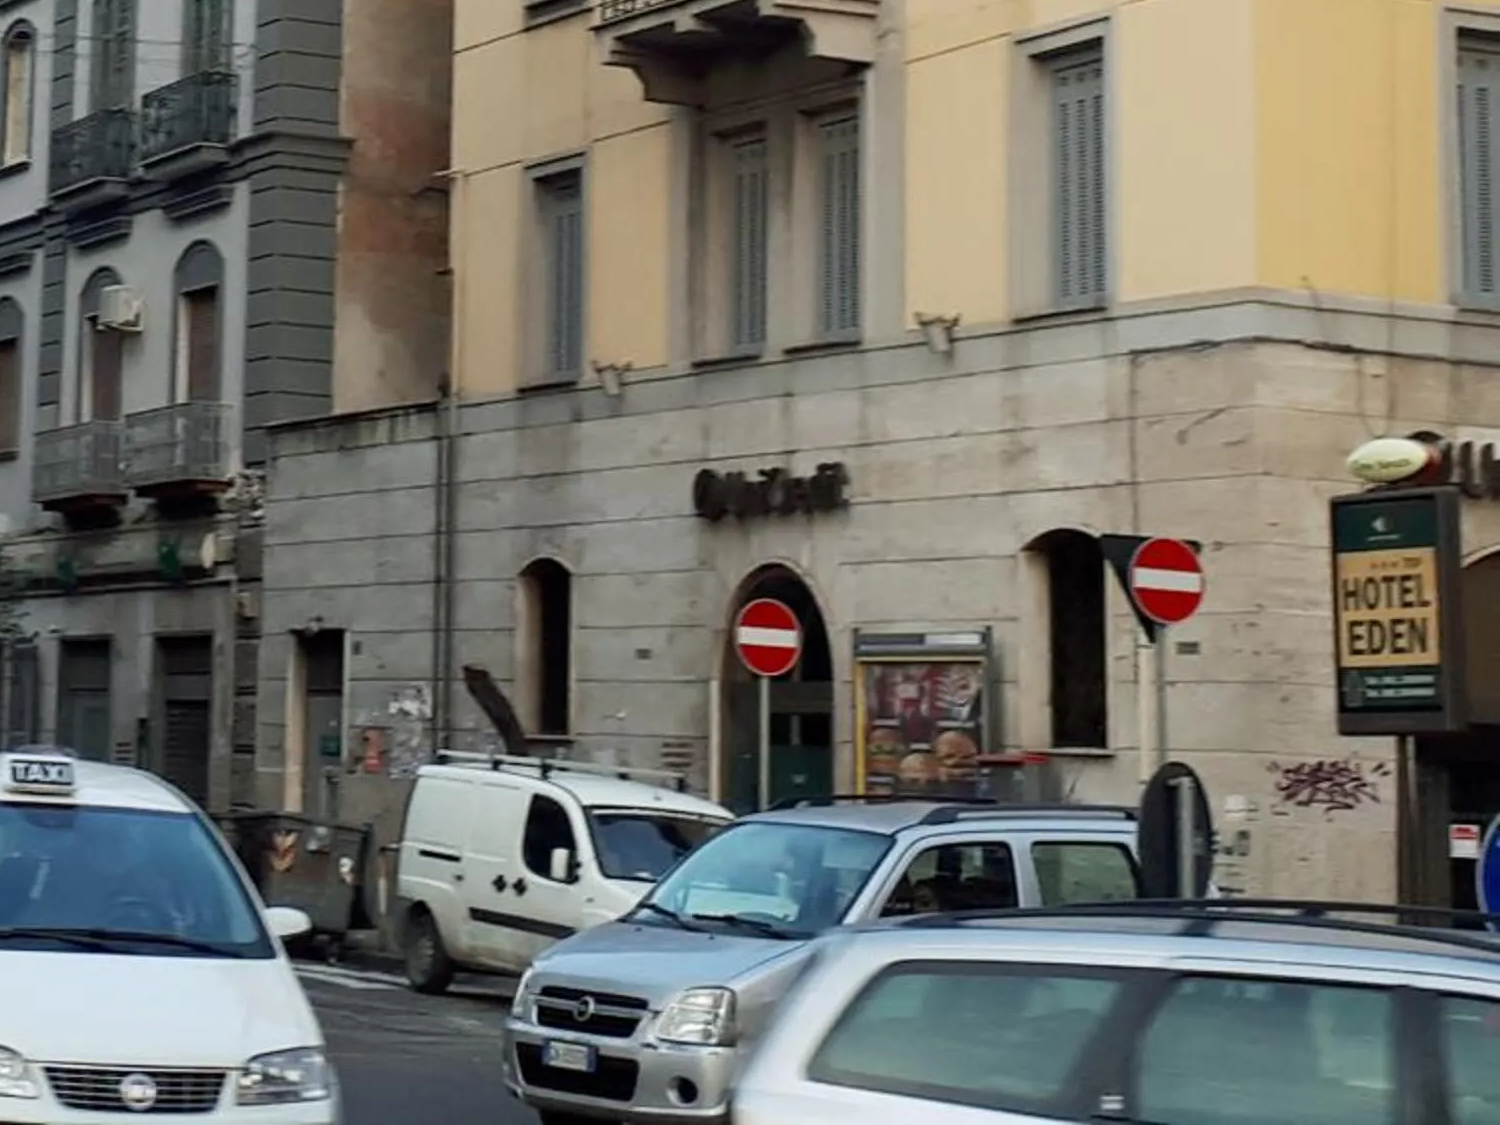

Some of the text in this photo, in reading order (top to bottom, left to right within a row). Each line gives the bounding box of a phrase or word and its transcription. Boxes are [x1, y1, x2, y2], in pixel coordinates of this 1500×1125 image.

[1343, 574, 1431, 611] HOTEL
[1348, 618, 1428, 655] EDEN
[11, 763, 69, 783] TAXI
